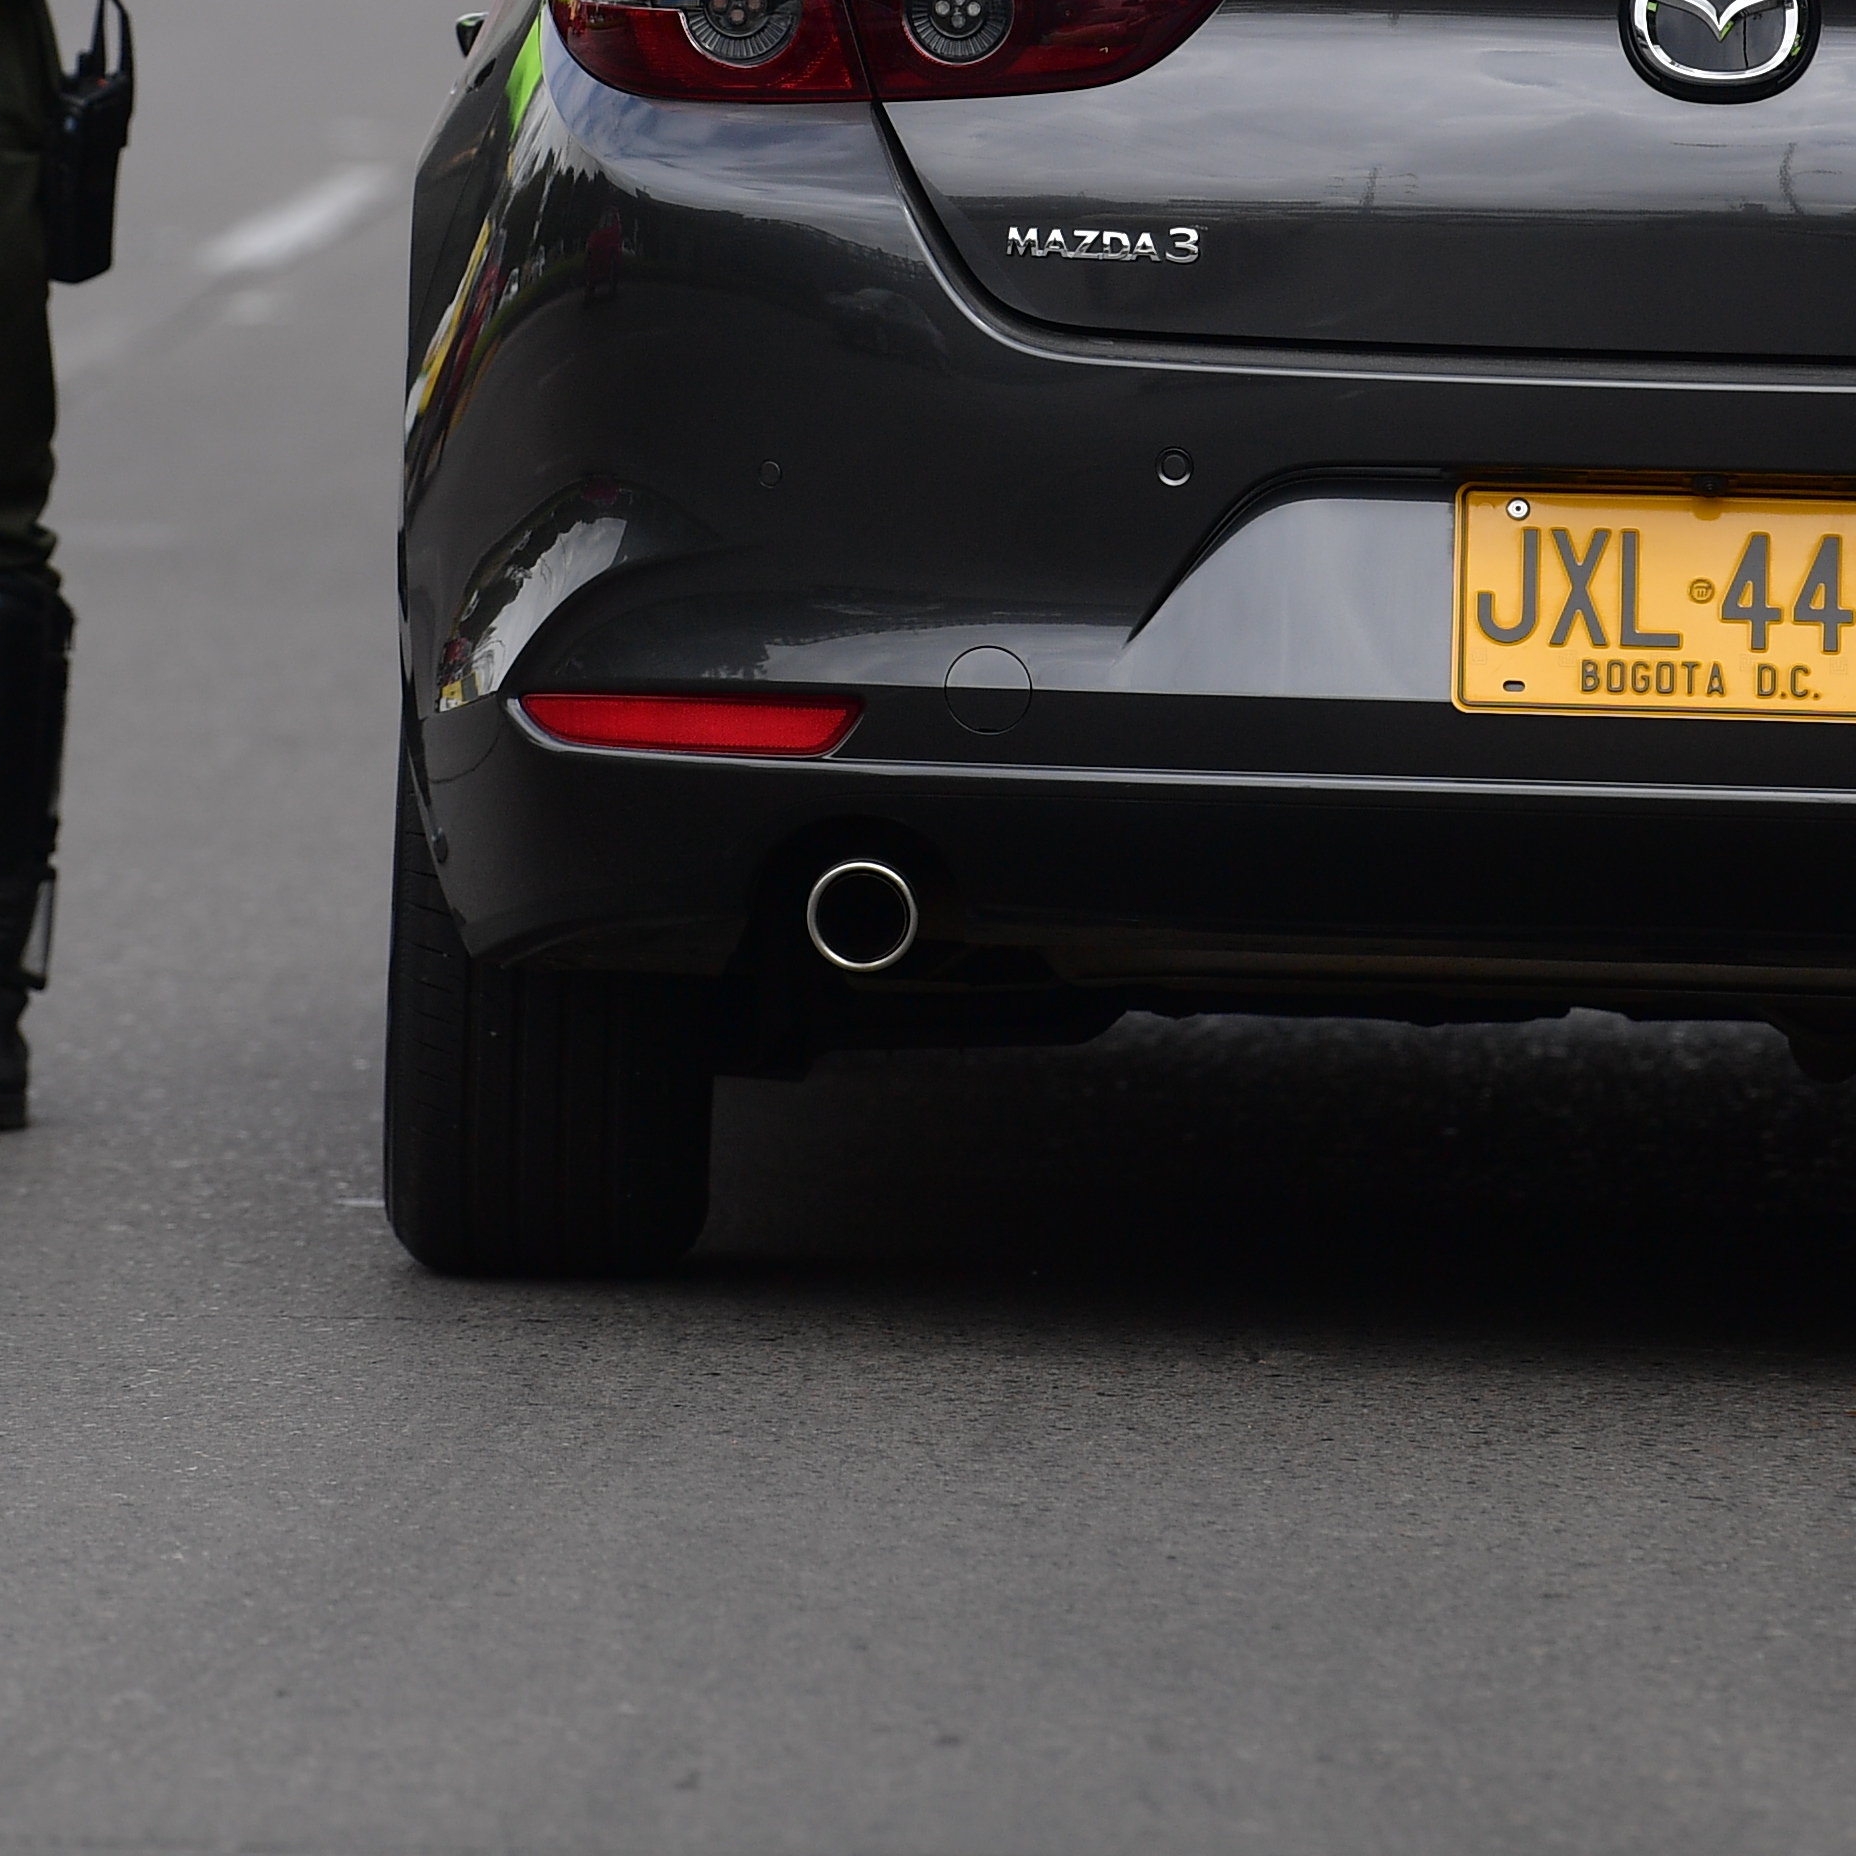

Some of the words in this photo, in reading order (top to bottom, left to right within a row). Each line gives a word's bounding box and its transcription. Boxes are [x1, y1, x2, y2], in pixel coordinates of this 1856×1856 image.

[1006, 226, 1162, 262] MAZDA
[1476, 527, 1682, 650] JXL
[1580, 658, 1726, 697] BOGOTA
[1755, 664, 1821, 700] D.C.
